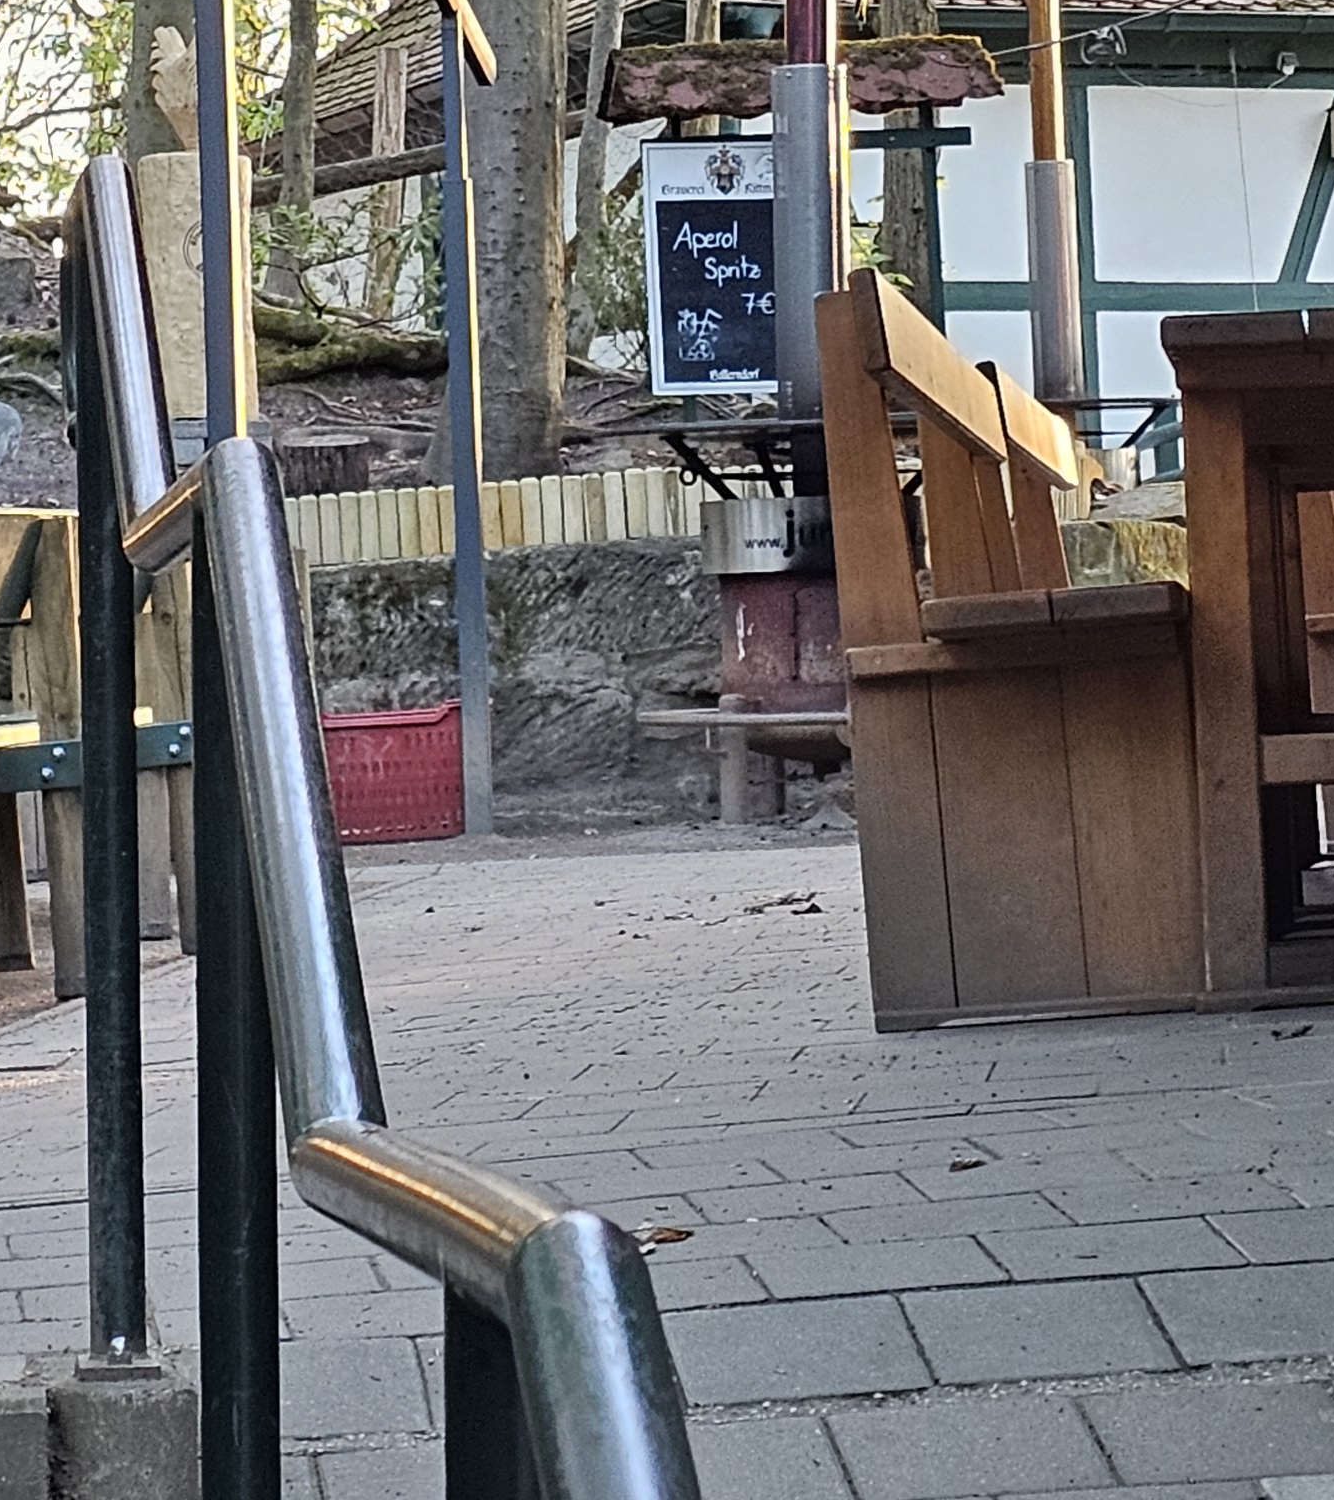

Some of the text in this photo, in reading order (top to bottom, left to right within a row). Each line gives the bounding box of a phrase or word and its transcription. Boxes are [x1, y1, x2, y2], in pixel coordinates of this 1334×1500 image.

[672, 220, 738, 259] Aperol
[704, 255, 761, 288] Spritz
[740, 292, 776, 316] 7€
